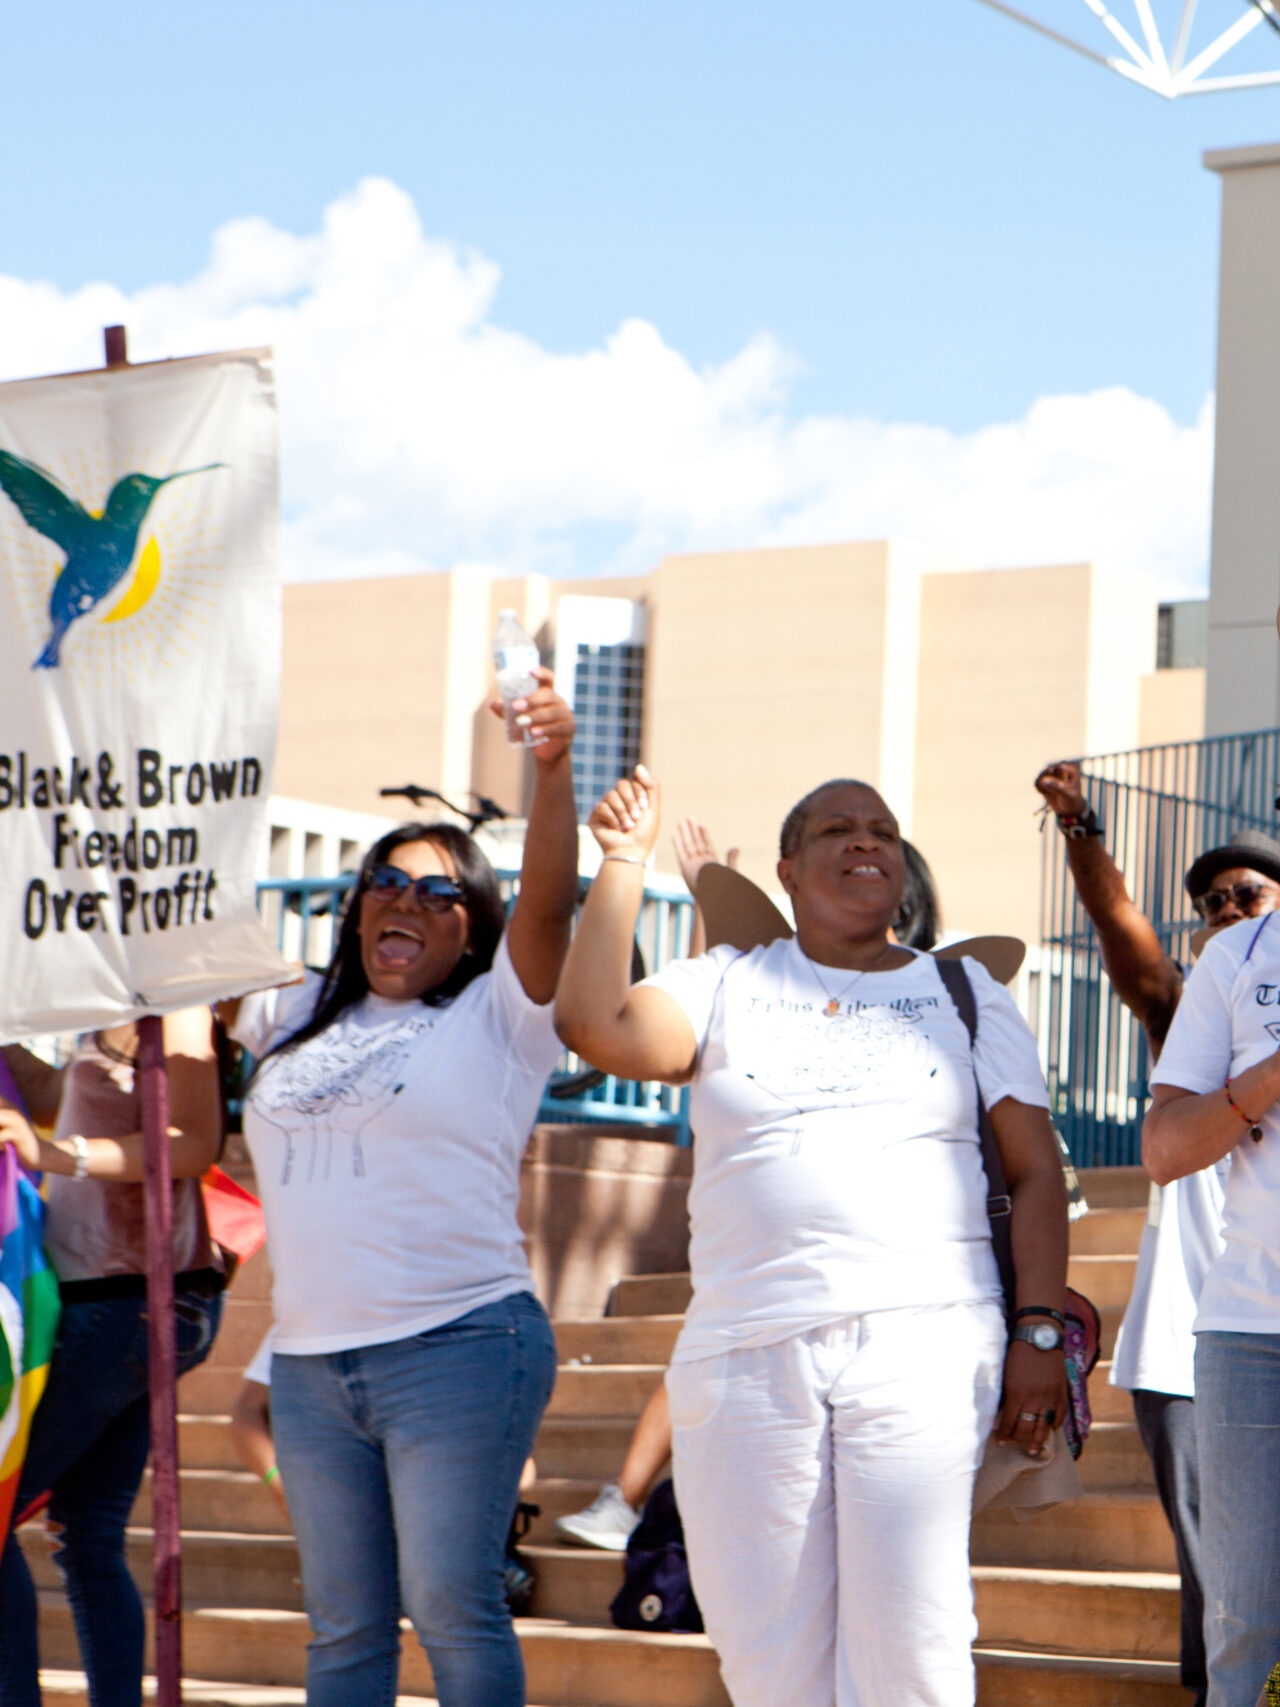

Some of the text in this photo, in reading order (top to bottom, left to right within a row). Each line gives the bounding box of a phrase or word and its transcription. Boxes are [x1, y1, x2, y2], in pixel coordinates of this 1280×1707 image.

[0, 750, 92, 810] Black
[137, 749, 261, 808] Brown
[118, 868, 217, 935] Profit
